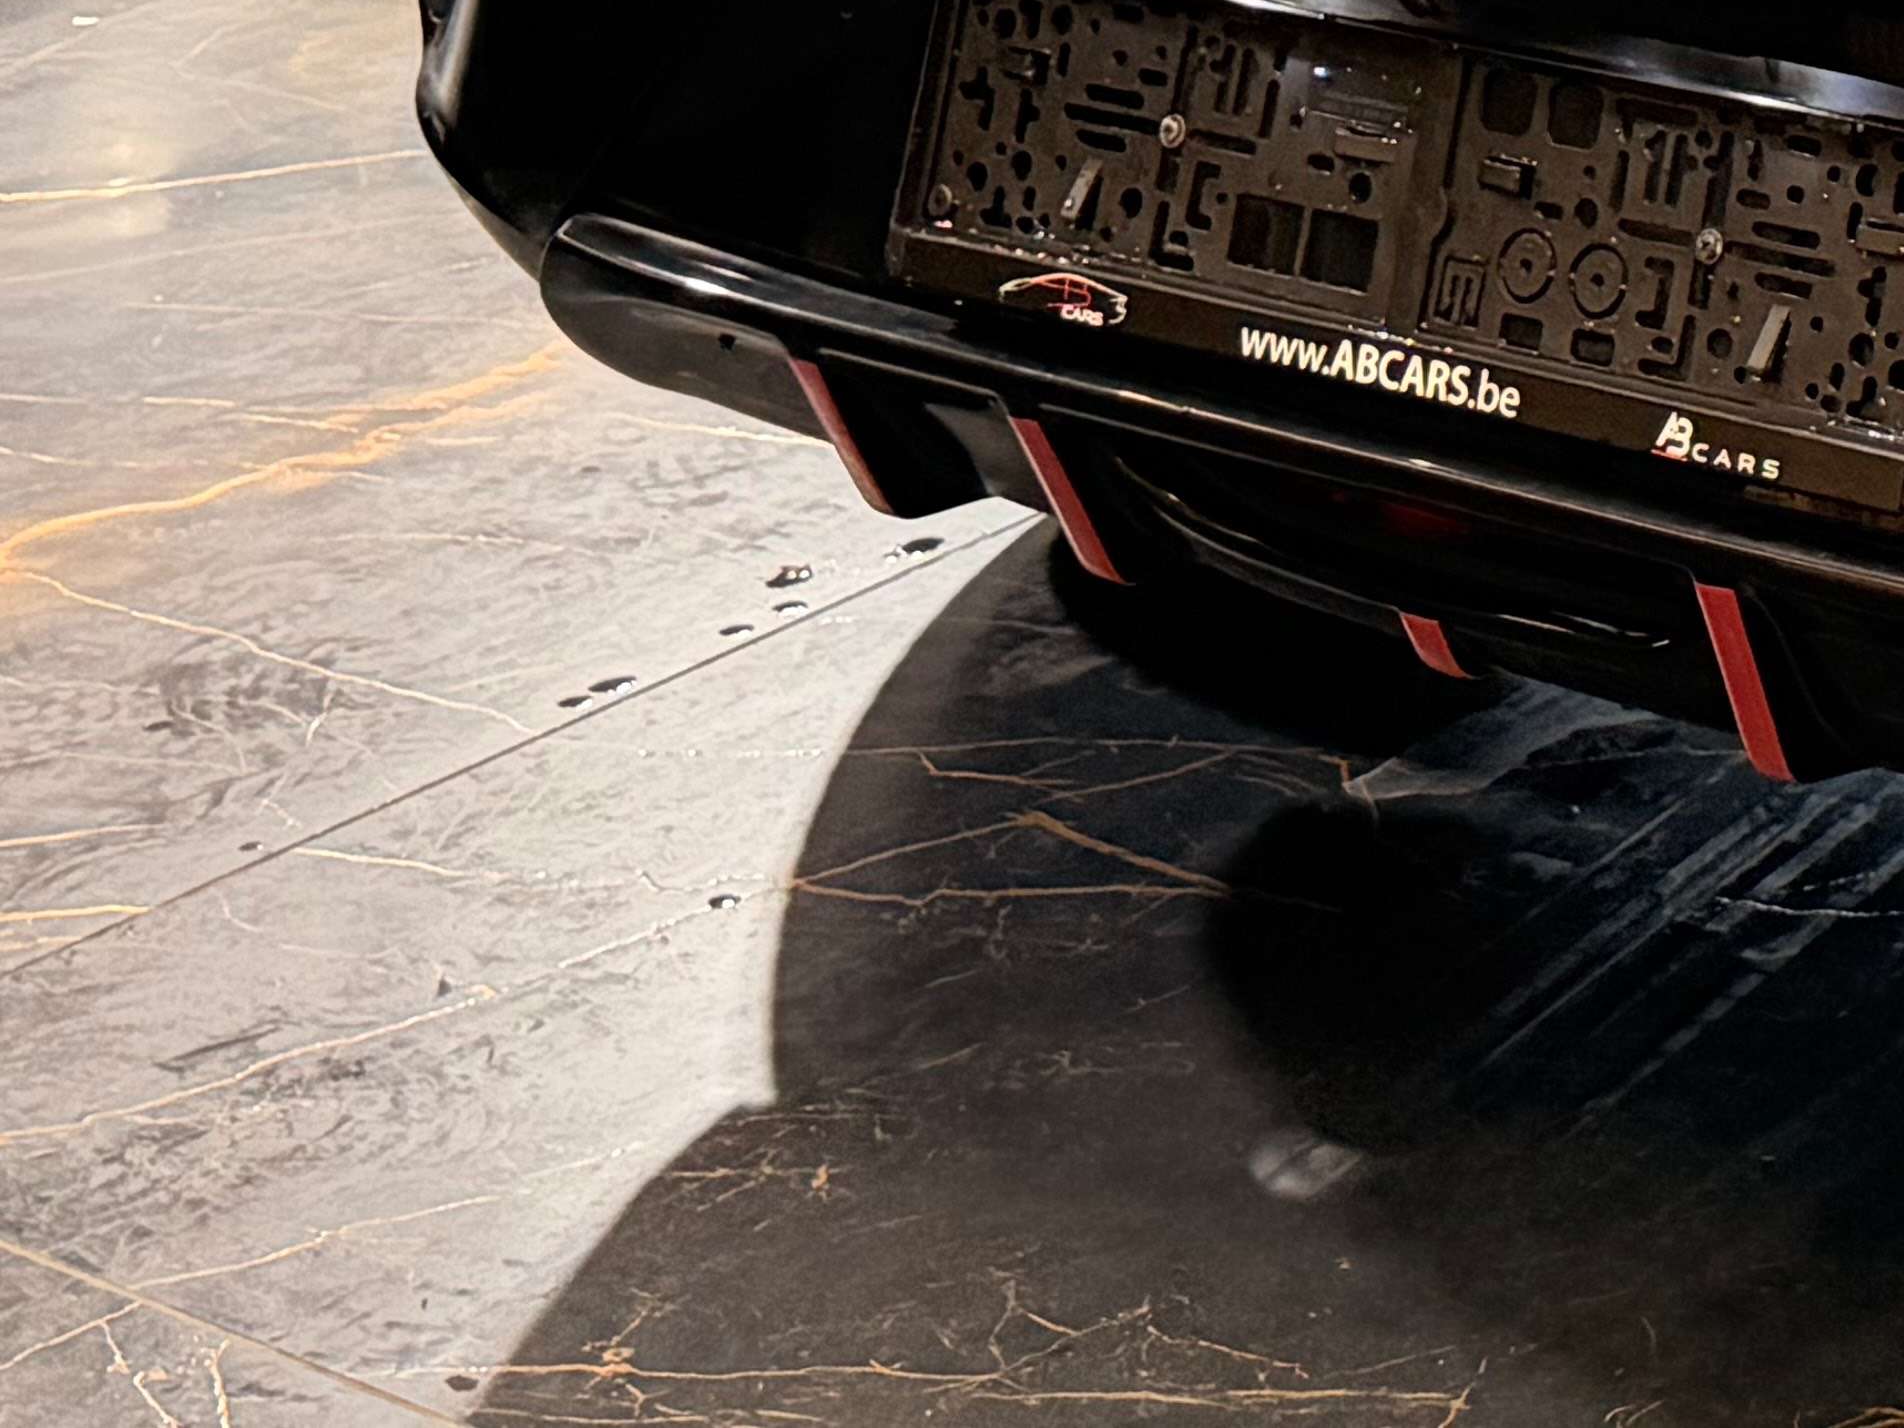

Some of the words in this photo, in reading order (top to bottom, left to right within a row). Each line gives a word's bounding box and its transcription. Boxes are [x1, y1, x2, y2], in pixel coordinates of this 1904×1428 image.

[1060, 304, 1104, 327] CARS
[1240, 326, 1521, 419] www.ABCARS.be
[1691, 442, 1780, 480] CARS
